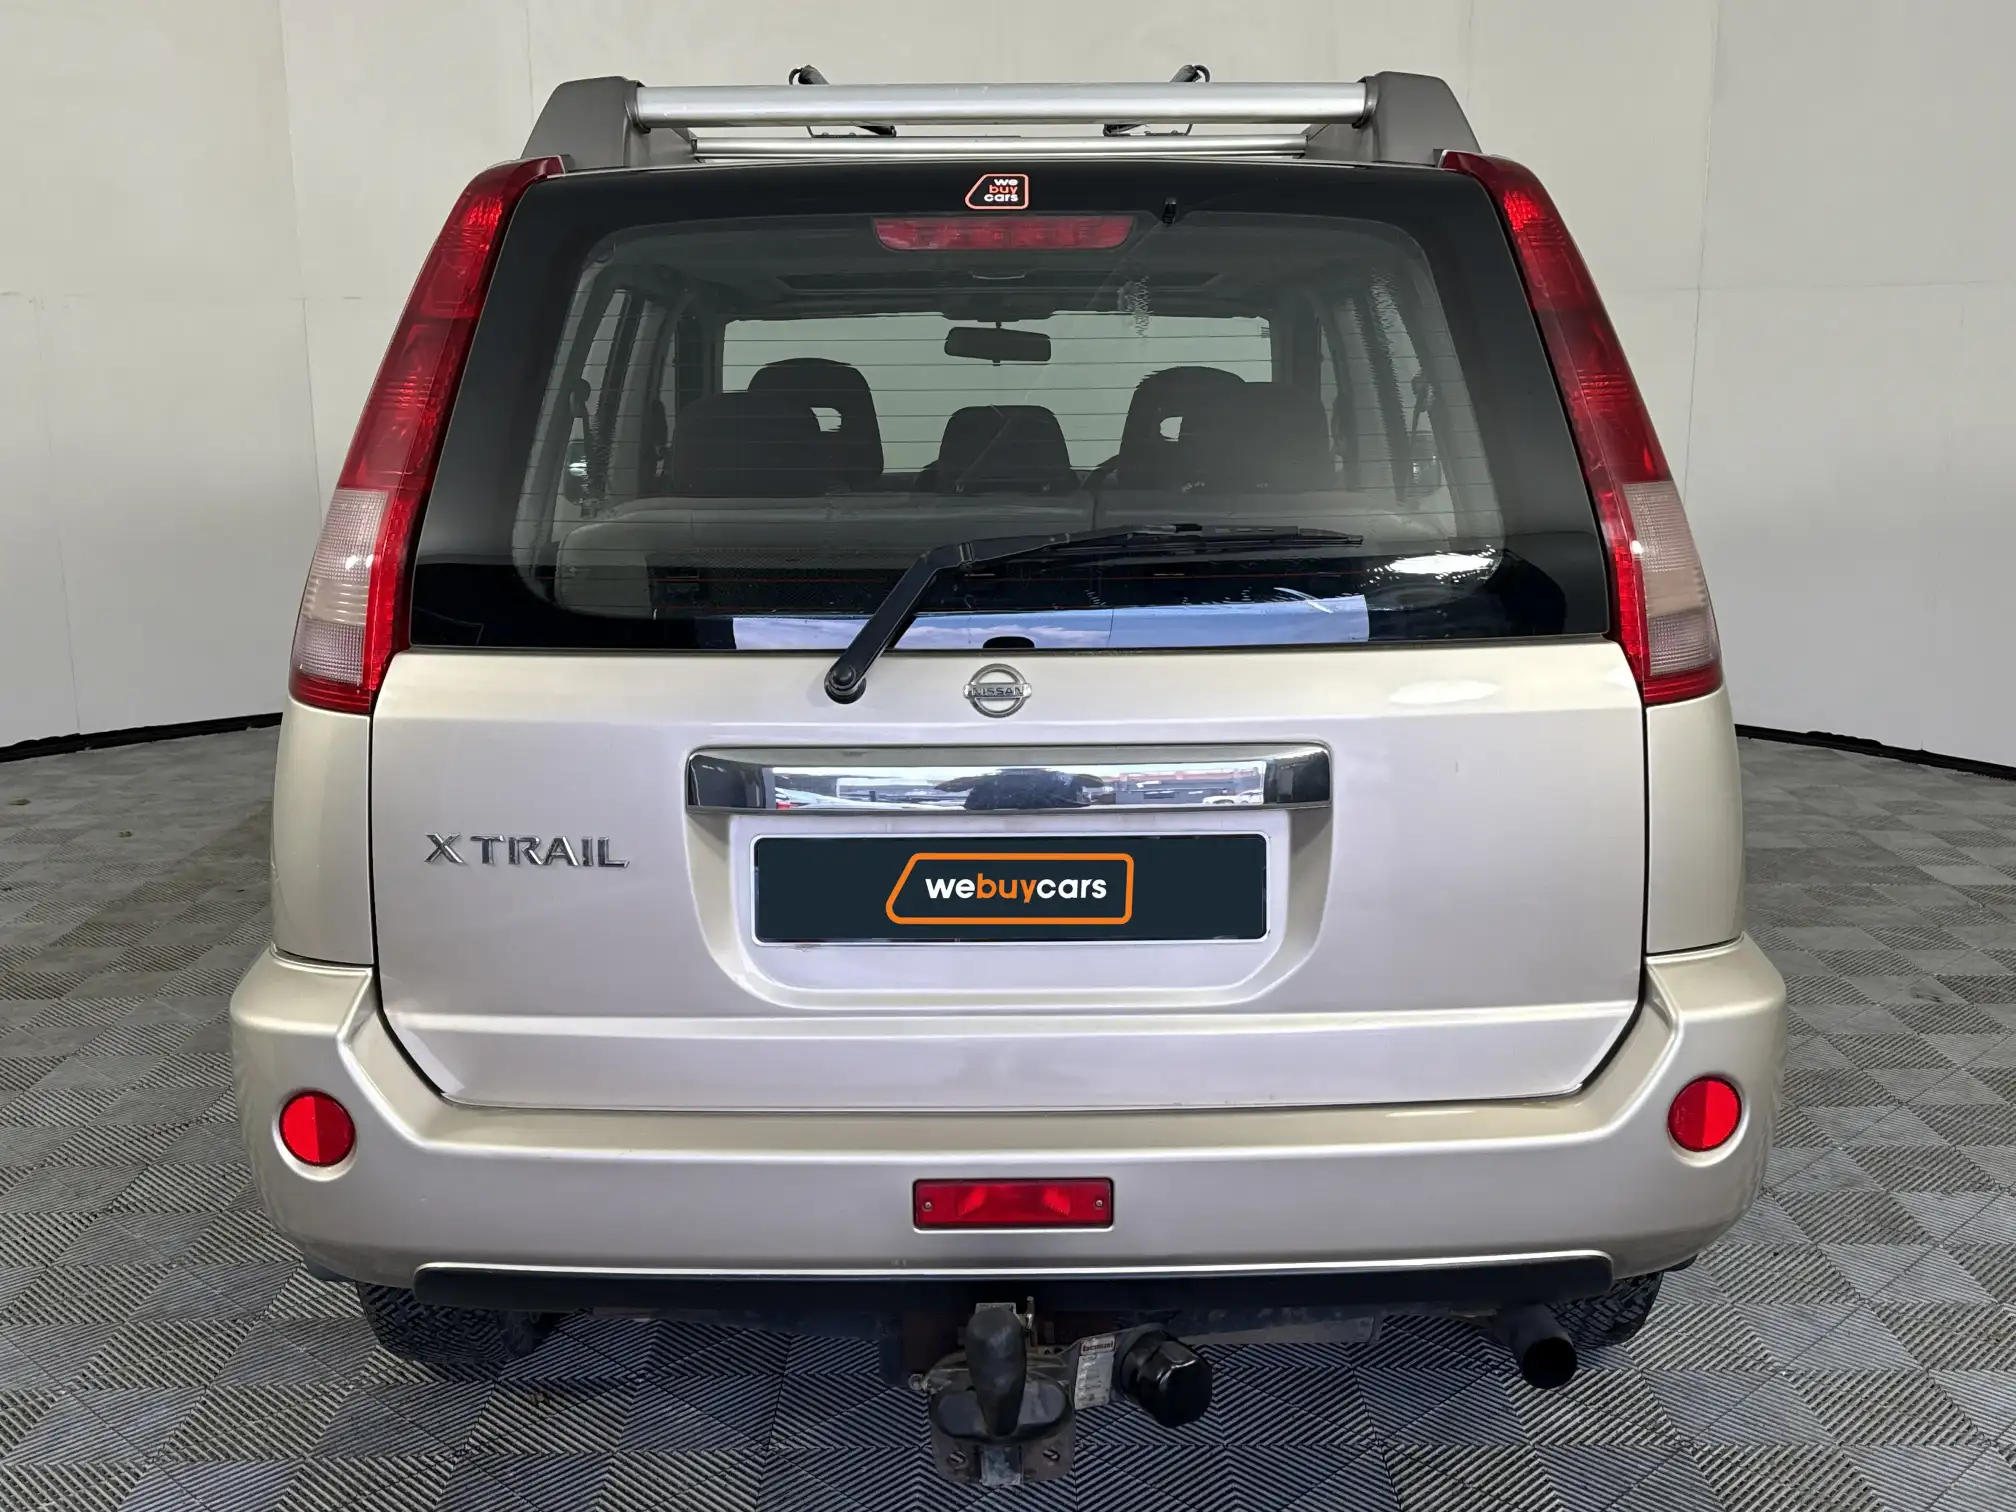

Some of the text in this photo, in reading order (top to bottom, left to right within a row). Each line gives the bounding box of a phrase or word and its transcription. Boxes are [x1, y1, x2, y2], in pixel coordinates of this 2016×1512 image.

[993, 178, 1019, 186] we
[988, 184, 1018, 195] buy
[983, 193, 1019, 202] cars
[971, 685, 1024, 697] NISSAN
[470, 834, 630, 868] TRAIL
